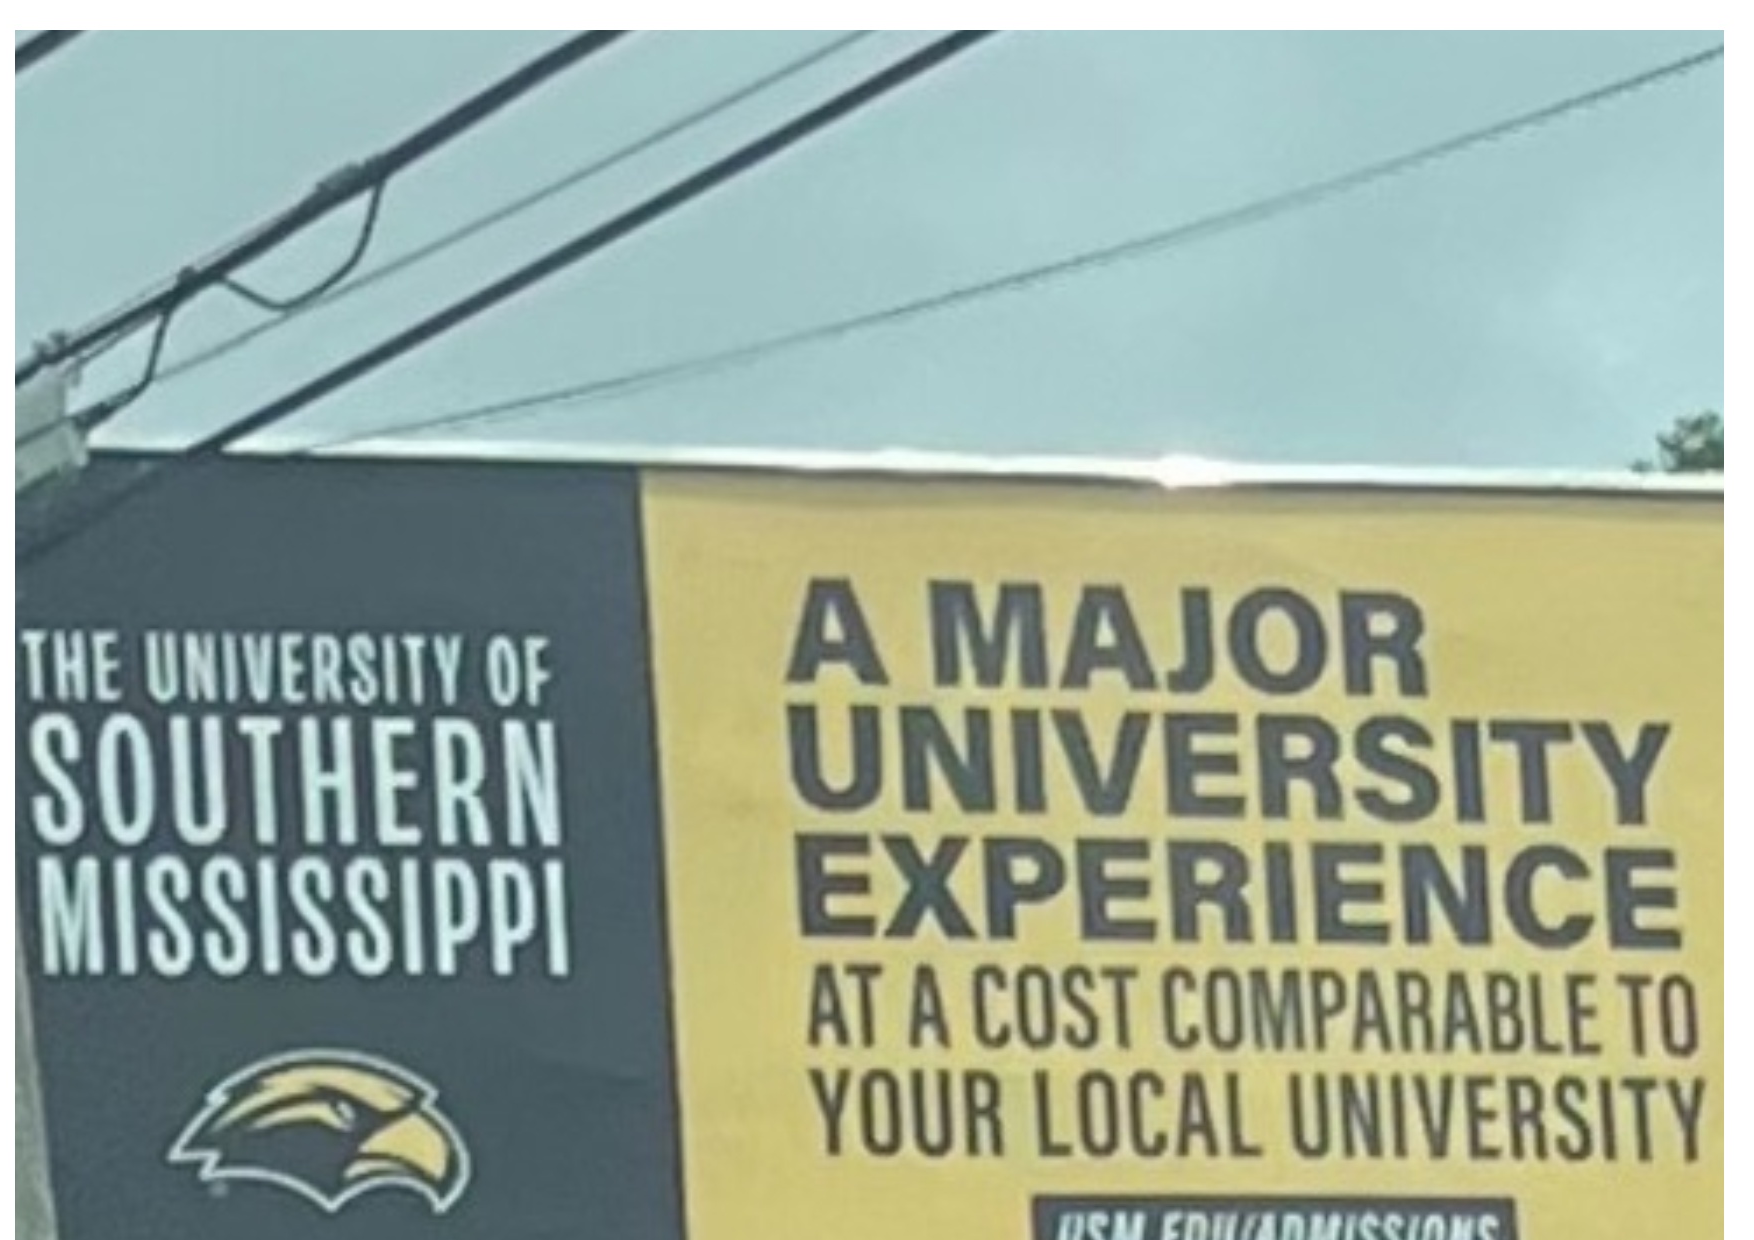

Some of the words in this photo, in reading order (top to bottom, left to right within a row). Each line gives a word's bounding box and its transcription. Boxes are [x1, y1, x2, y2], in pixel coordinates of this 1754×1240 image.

[21, 630, 121, 701] THE
[146, 630, 461, 707] UNIVERSITY
[487, 636, 550, 707] OF
[785, 577, 889, 687] A
[928, 579, 1429, 697] MAJOR
[29, 713, 562, 848] SOUTHERN
[787, 704, 1671, 827] UNIVERSITY
[38, 856, 570, 976] MISSISSIPPI
[794, 831, 1685, 951] EXPERIENCE
[807, 963, 882, 1049] AT
[908, 965, 951, 1049] A
[972, 965, 1139, 1051] COST
[1162, 967, 1601, 1056] COMPARABLE
[1617, 973, 1699, 1058] TO
[808, 1067, 1005, 1159] YOUR
[1037, 1069, 1262, 1159] LOCAL
[1289, 1073, 1706, 1163] UNIVERSITY
